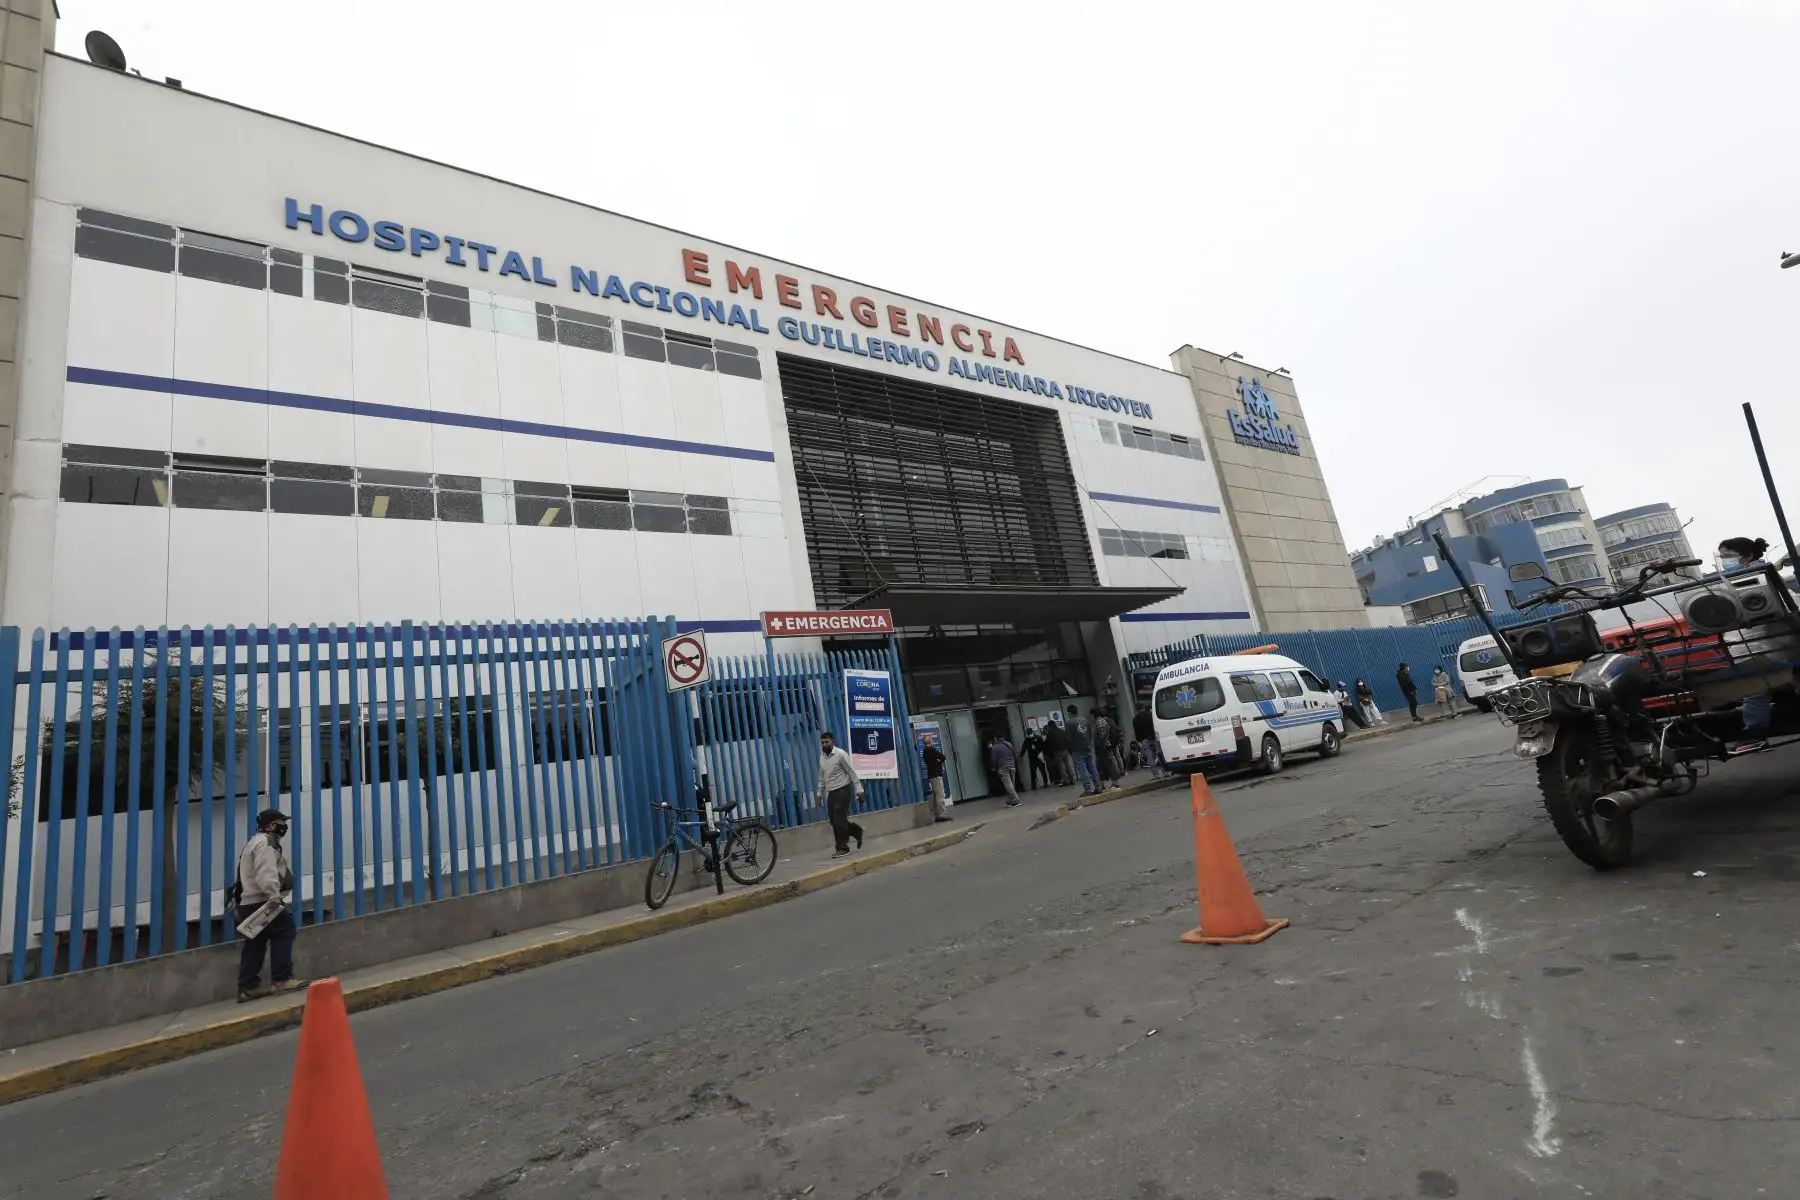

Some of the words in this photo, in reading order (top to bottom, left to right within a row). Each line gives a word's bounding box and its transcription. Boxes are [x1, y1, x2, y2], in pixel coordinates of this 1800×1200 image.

[284, 196, 556, 287] HOSPITAL
[570, 264, 769, 334] NACIONAL
[777, 316, 940, 373] GUILLERMO
[948, 356, 1063, 400] ALMENARA
[1067, 384, 1153, 420] IRIGOYEN
[682, 248, 1026, 366] EMERGENCIA
[785, 615, 887, 630] EMERGENCIA
[1159, 662, 1210, 681] AMBULANCIA
